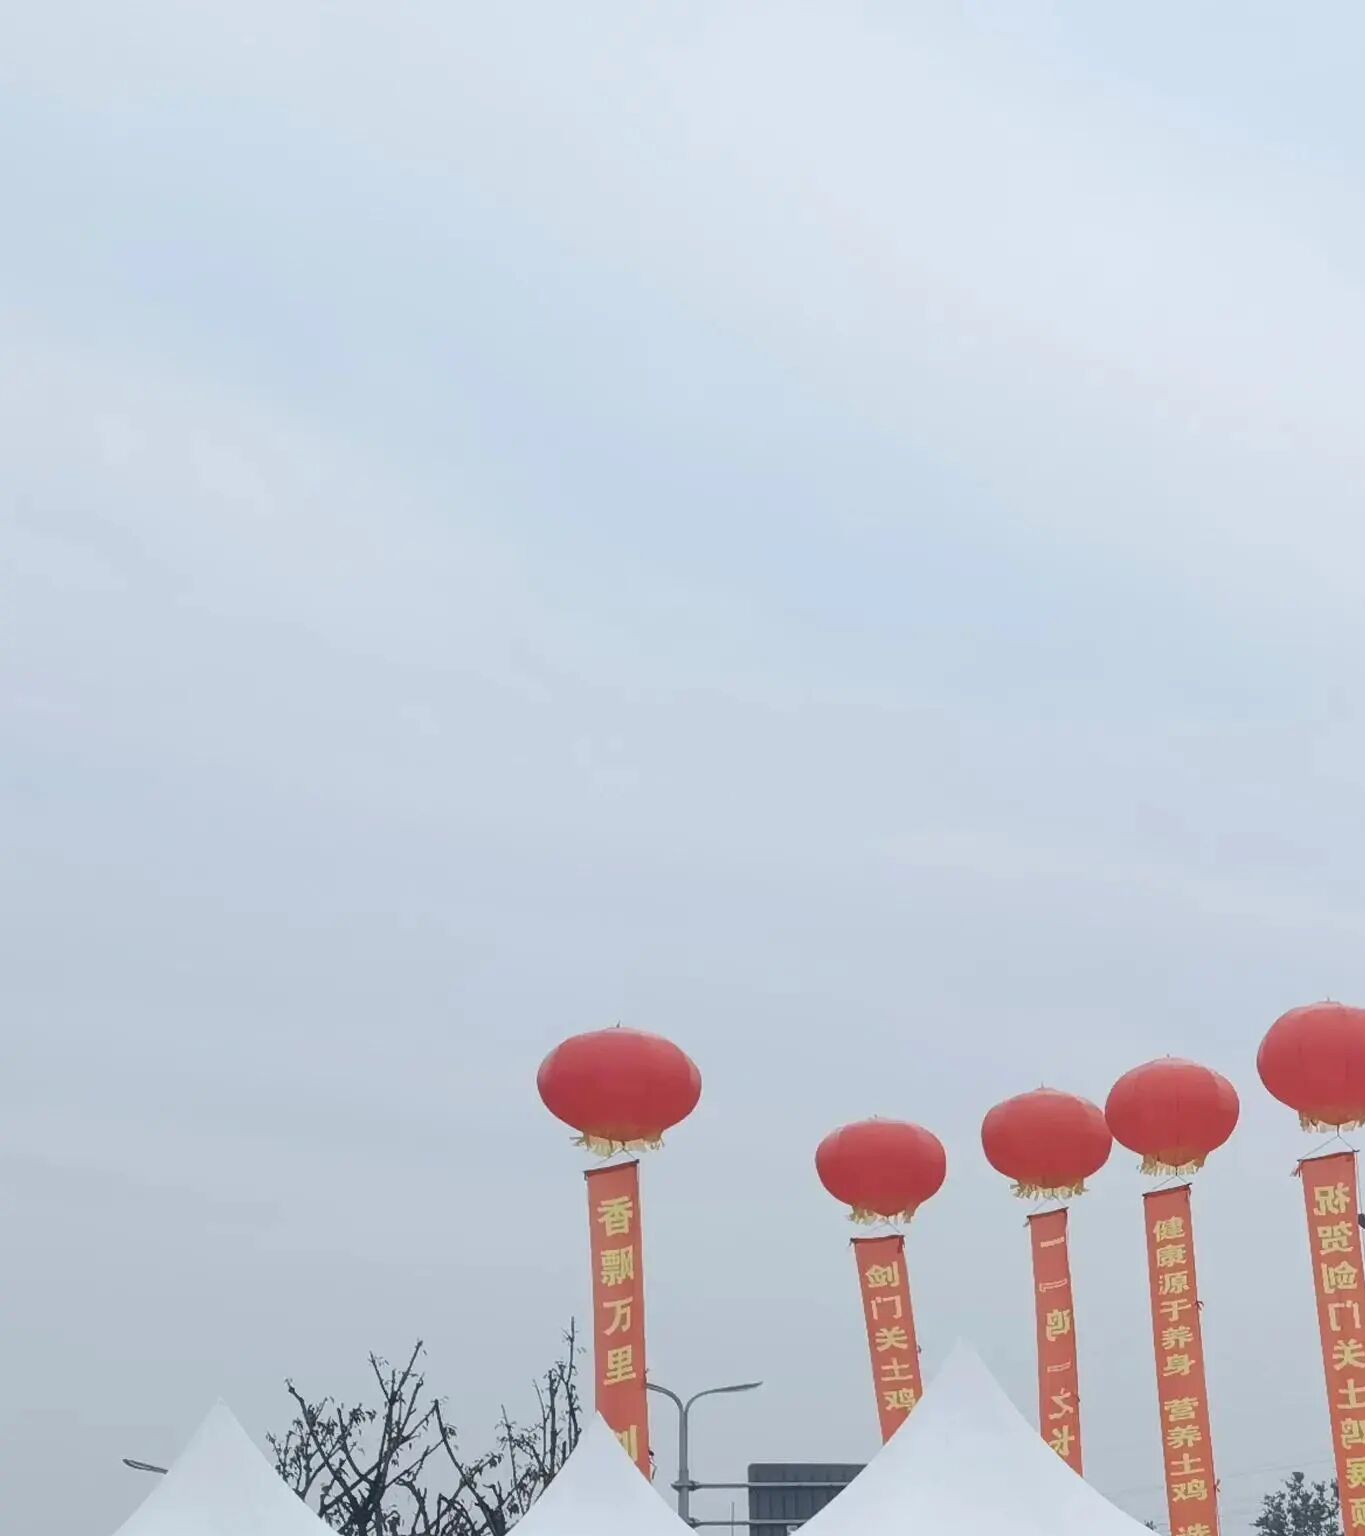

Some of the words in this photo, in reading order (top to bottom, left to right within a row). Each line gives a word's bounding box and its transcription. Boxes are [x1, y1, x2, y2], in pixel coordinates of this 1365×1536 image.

[597, 1195, 637, 1386] 香飘万里
[865, 1261, 917, 1412] 剑门关土鸡
[1152, 1215, 1196, 1377] 健康源于养身
[1163, 1396, 1209, 1502] 营养土鸡
